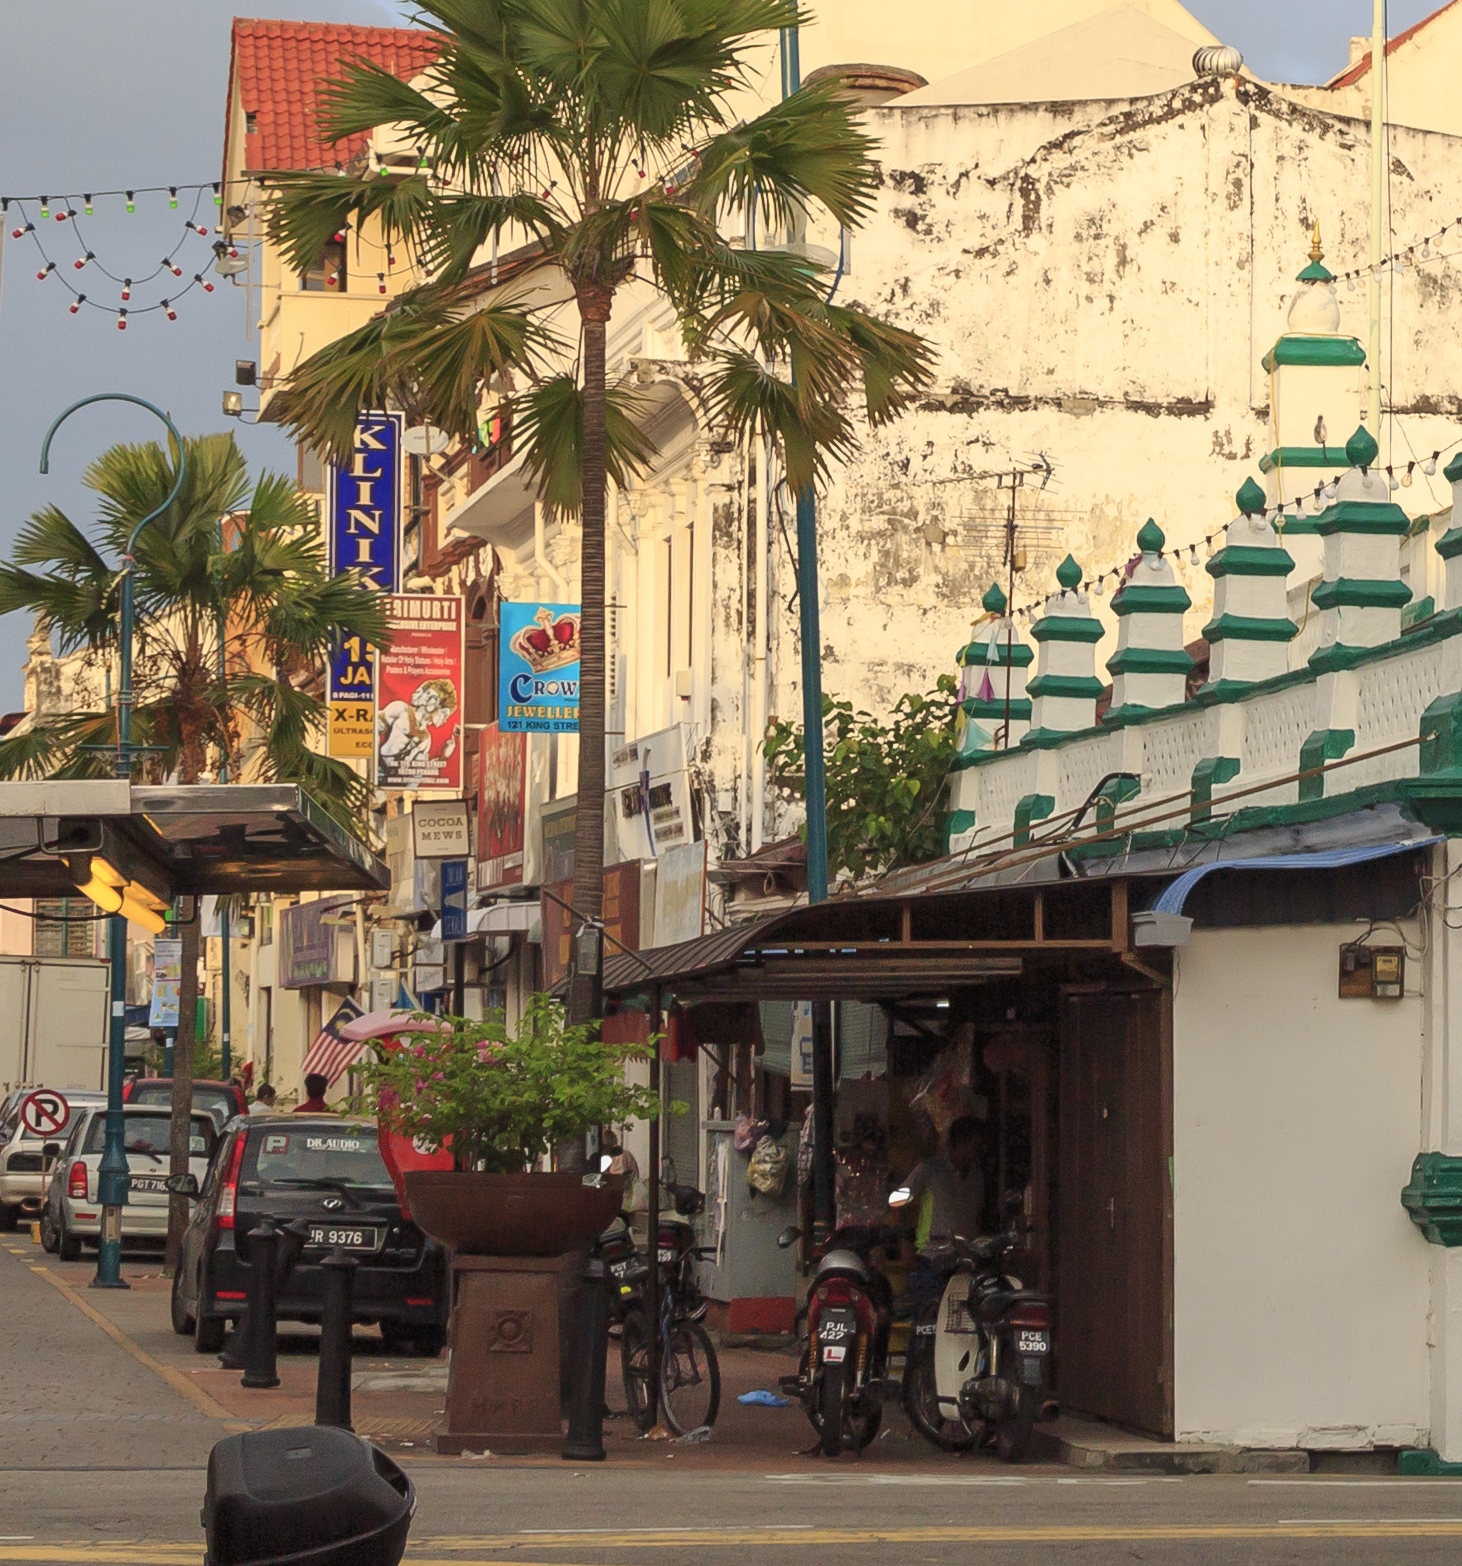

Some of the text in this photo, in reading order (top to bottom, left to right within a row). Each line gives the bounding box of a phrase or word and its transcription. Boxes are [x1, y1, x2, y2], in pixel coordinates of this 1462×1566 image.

[345, 424, 388, 591] KLINIK
[340, 666, 374, 684] JA
[509, 673, 579, 704] CROW
[334, 708, 373, 722] X-R
[526, 721, 550, 730] KING
[418, 818, 463, 827] COCOA
[421, 831, 462, 840] MEWS
[266, 1136, 287, 1151] P
[151, 1180, 168, 1191] 716
[328, 1230, 363, 1244] 9376
[826, 1322, 848, 1332] PJL
[1021, 1331, 1042, 1341] PCE
[1019, 1340, 1047, 1351] 5390
[826, 1349, 841, 1359] L
